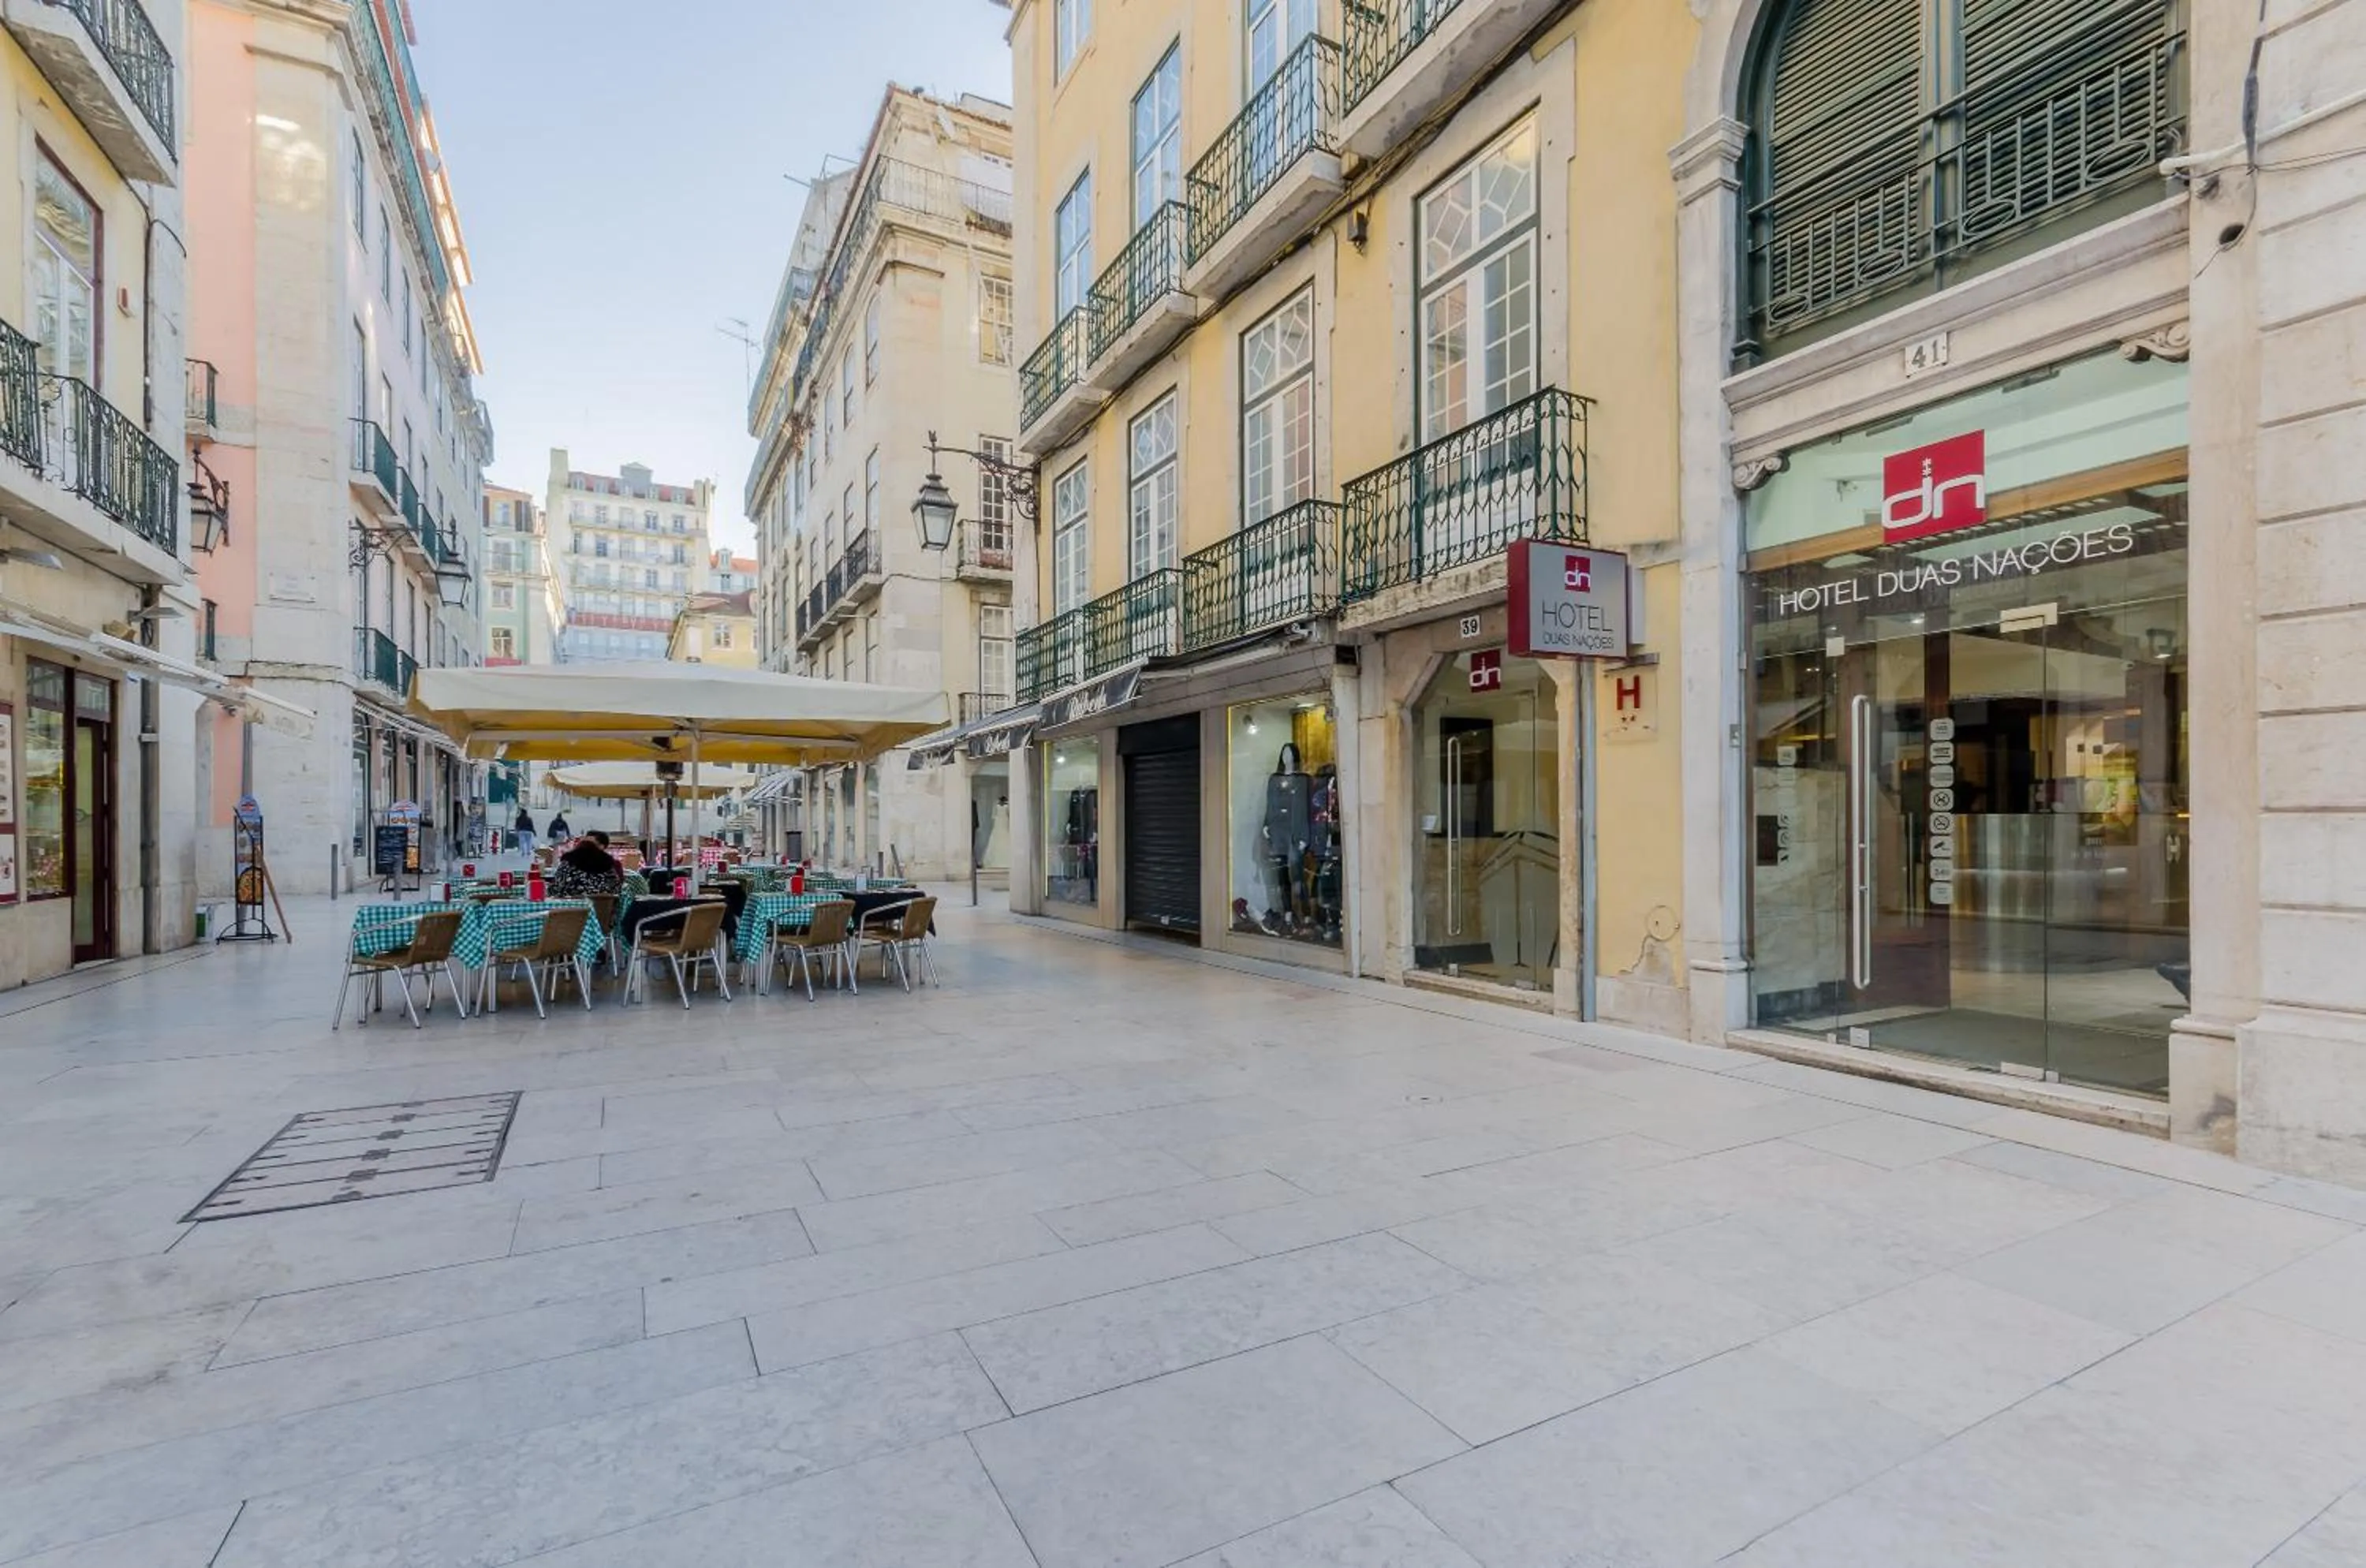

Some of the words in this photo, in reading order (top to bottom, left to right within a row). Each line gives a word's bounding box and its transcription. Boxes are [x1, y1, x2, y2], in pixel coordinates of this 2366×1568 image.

[1911, 339, 1939, 368] 41
[1779, 578, 1869, 616] HOTEL
[1878, 558, 1962, 597] DUAS
[1973, 524, 2133, 581] NAÇÕES
[1462, 618, 1478, 635] 39
[1542, 599, 1614, 632] HOTEL
[1616, 674, 1640, 710] H
